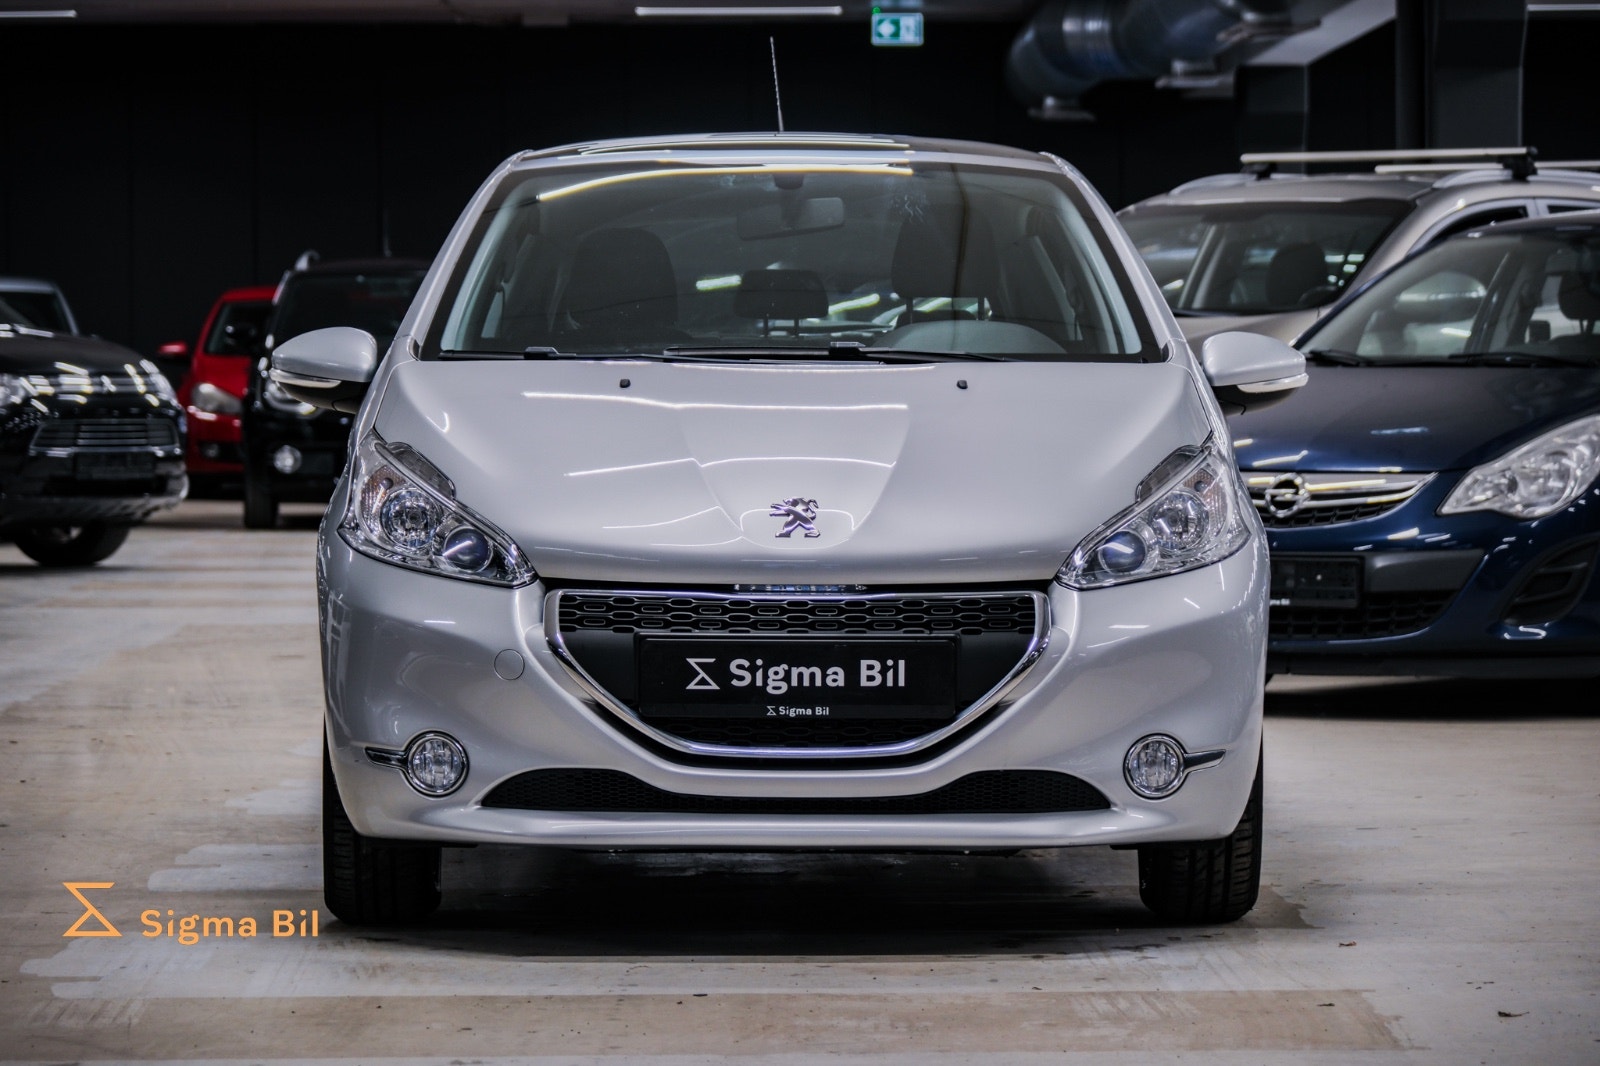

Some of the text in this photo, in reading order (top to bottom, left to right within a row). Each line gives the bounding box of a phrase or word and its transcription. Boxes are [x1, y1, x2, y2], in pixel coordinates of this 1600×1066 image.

[729, 658, 906, 695] Sigma Bil
[778, 706, 830, 718] Sigma Bil
